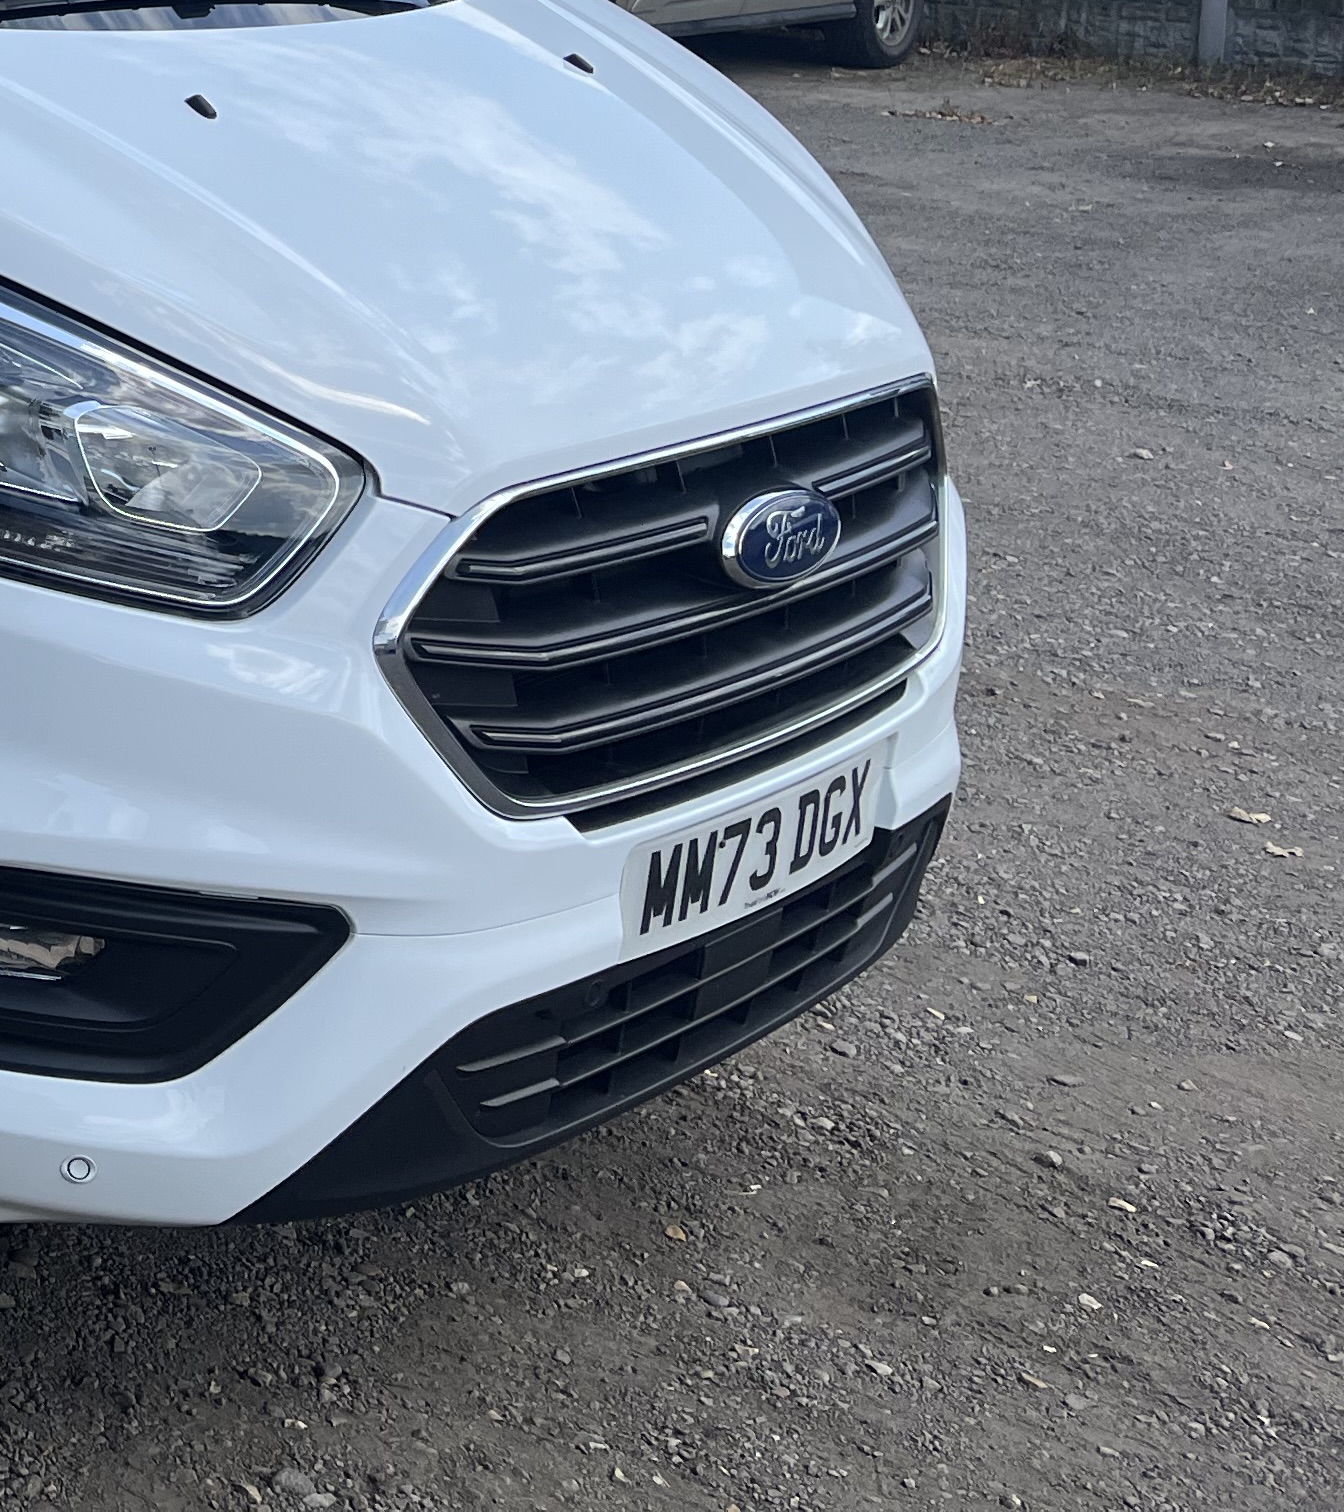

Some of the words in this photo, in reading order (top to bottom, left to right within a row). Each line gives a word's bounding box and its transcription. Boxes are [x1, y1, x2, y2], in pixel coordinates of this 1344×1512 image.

[764, 505, 826, 569] Ford
[639, 807, 782, 936] MM73
[788, 758, 871, 875] DGX
